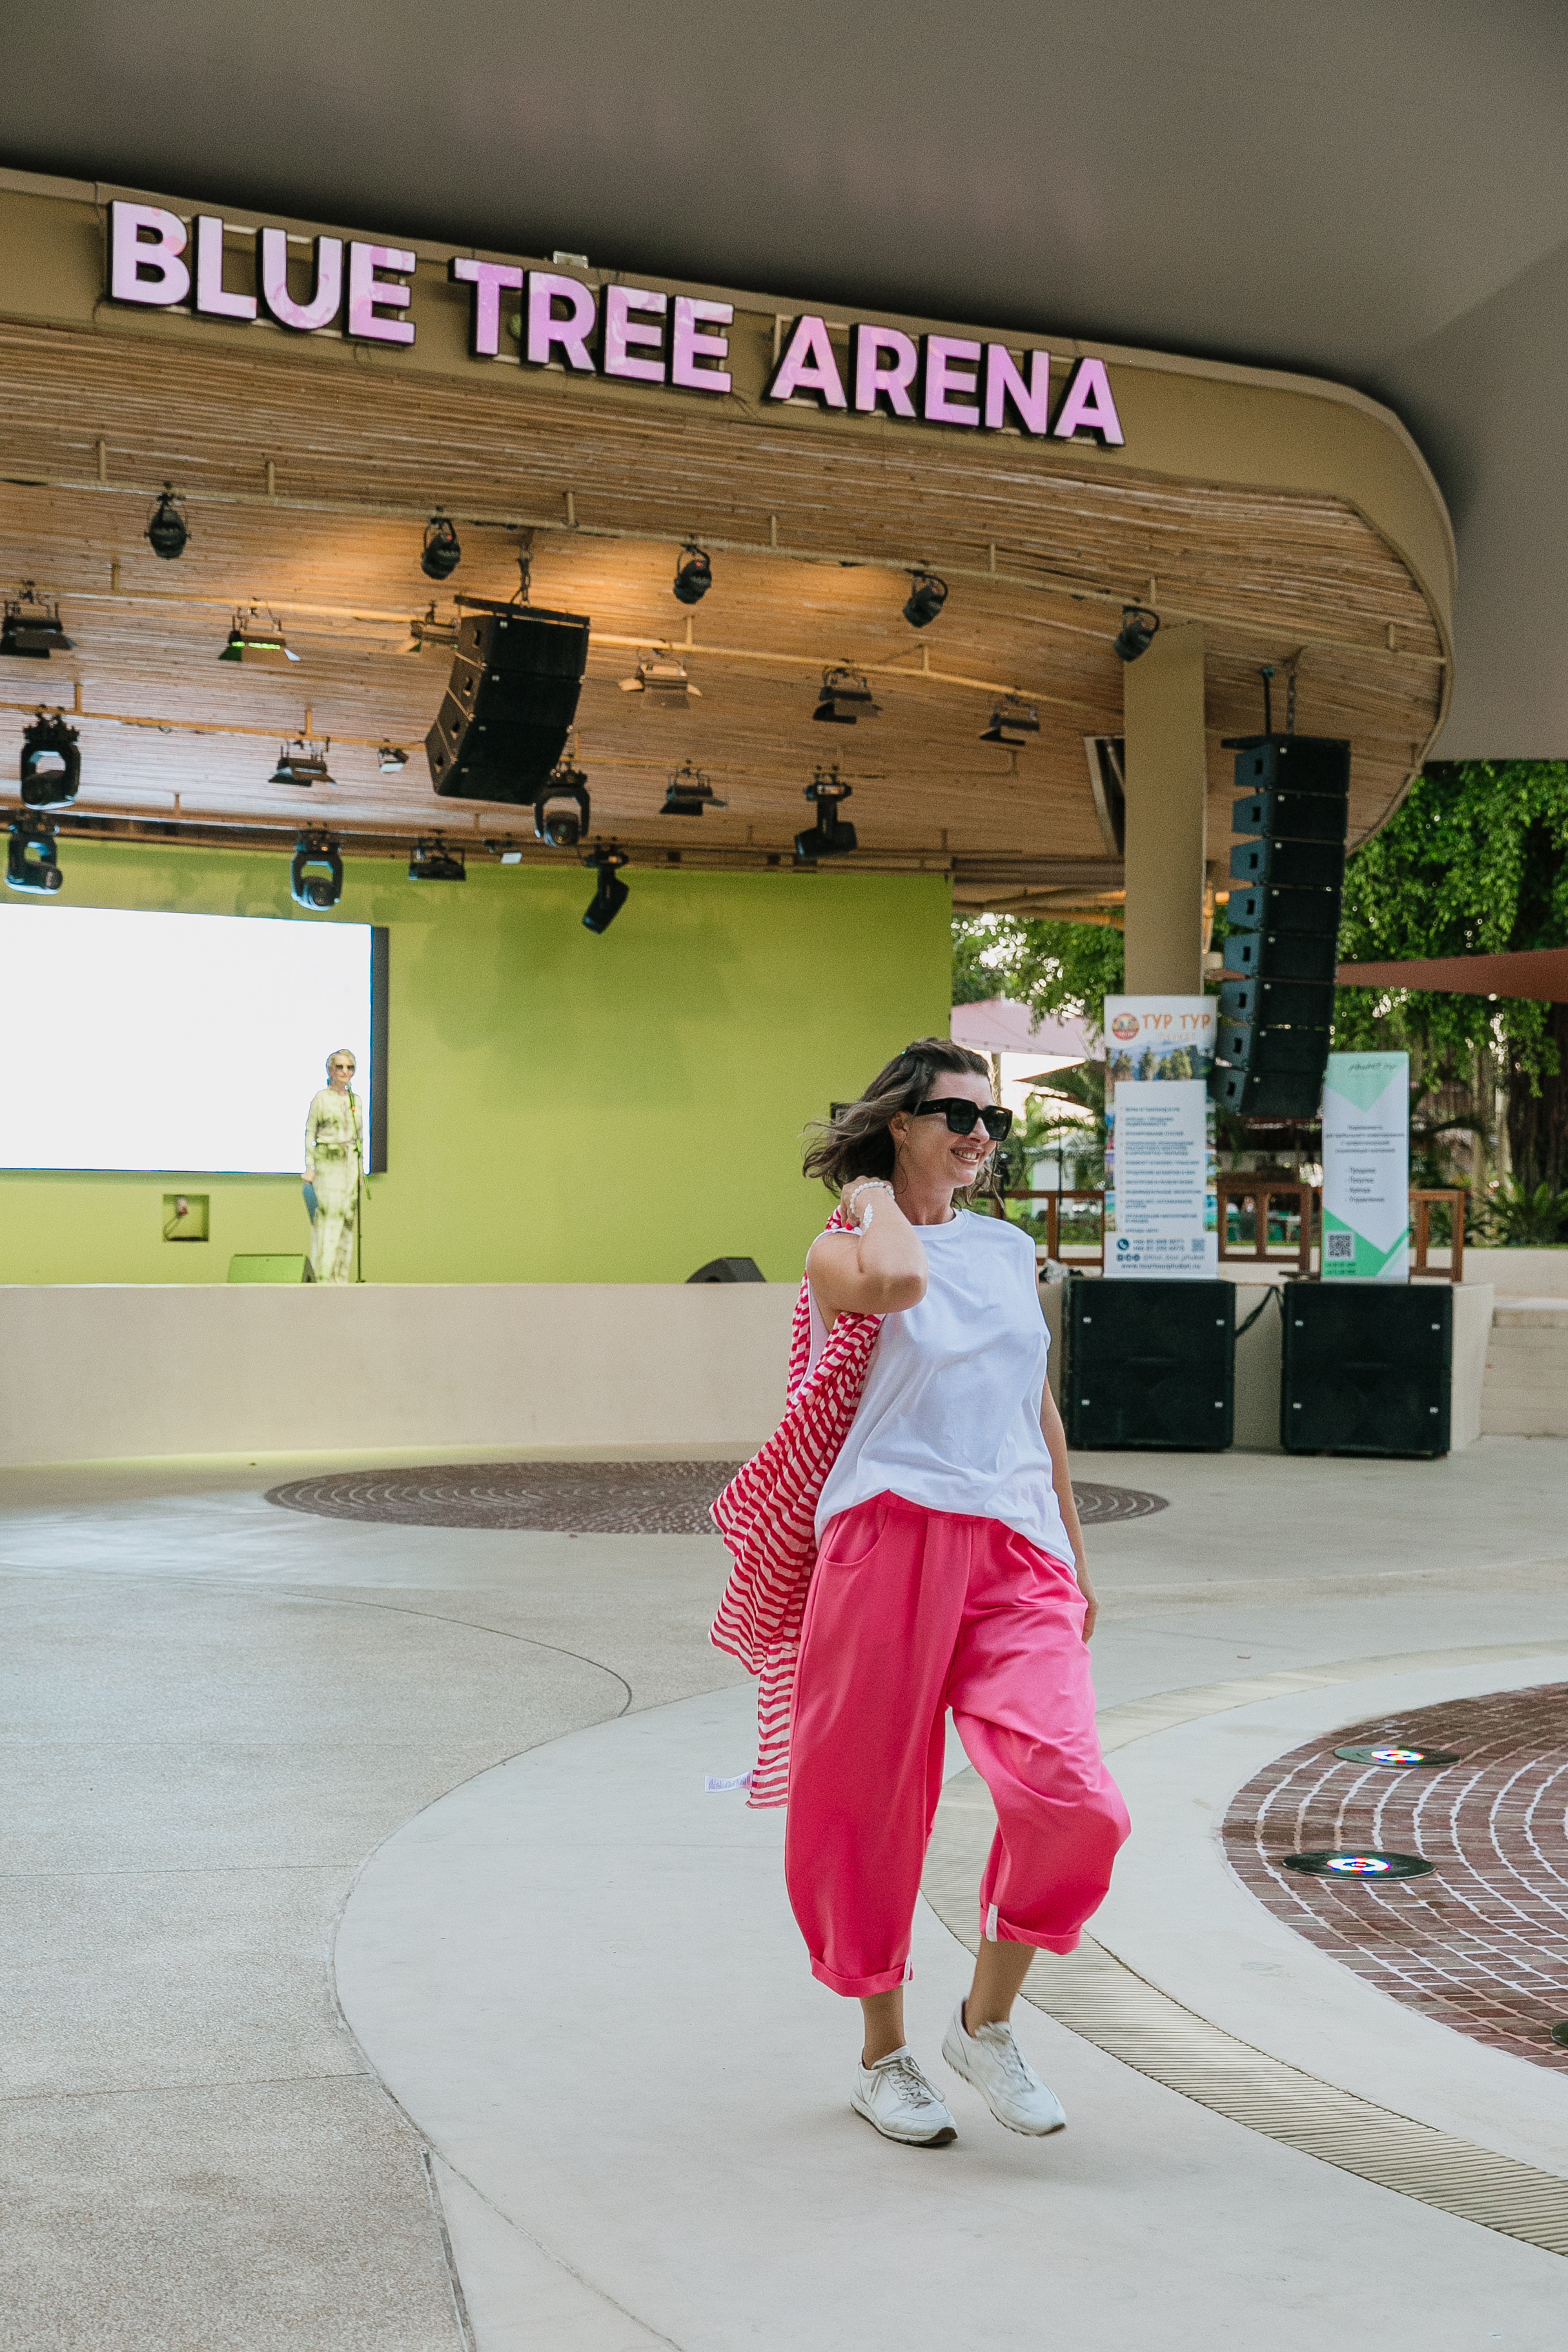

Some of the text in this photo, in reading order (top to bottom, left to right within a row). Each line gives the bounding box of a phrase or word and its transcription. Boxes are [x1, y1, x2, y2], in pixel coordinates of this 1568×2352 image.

[111, 199, 1126, 446] BLUE TREE ARENA
[1141, 1013, 1210, 1030] ТУР ТУР
